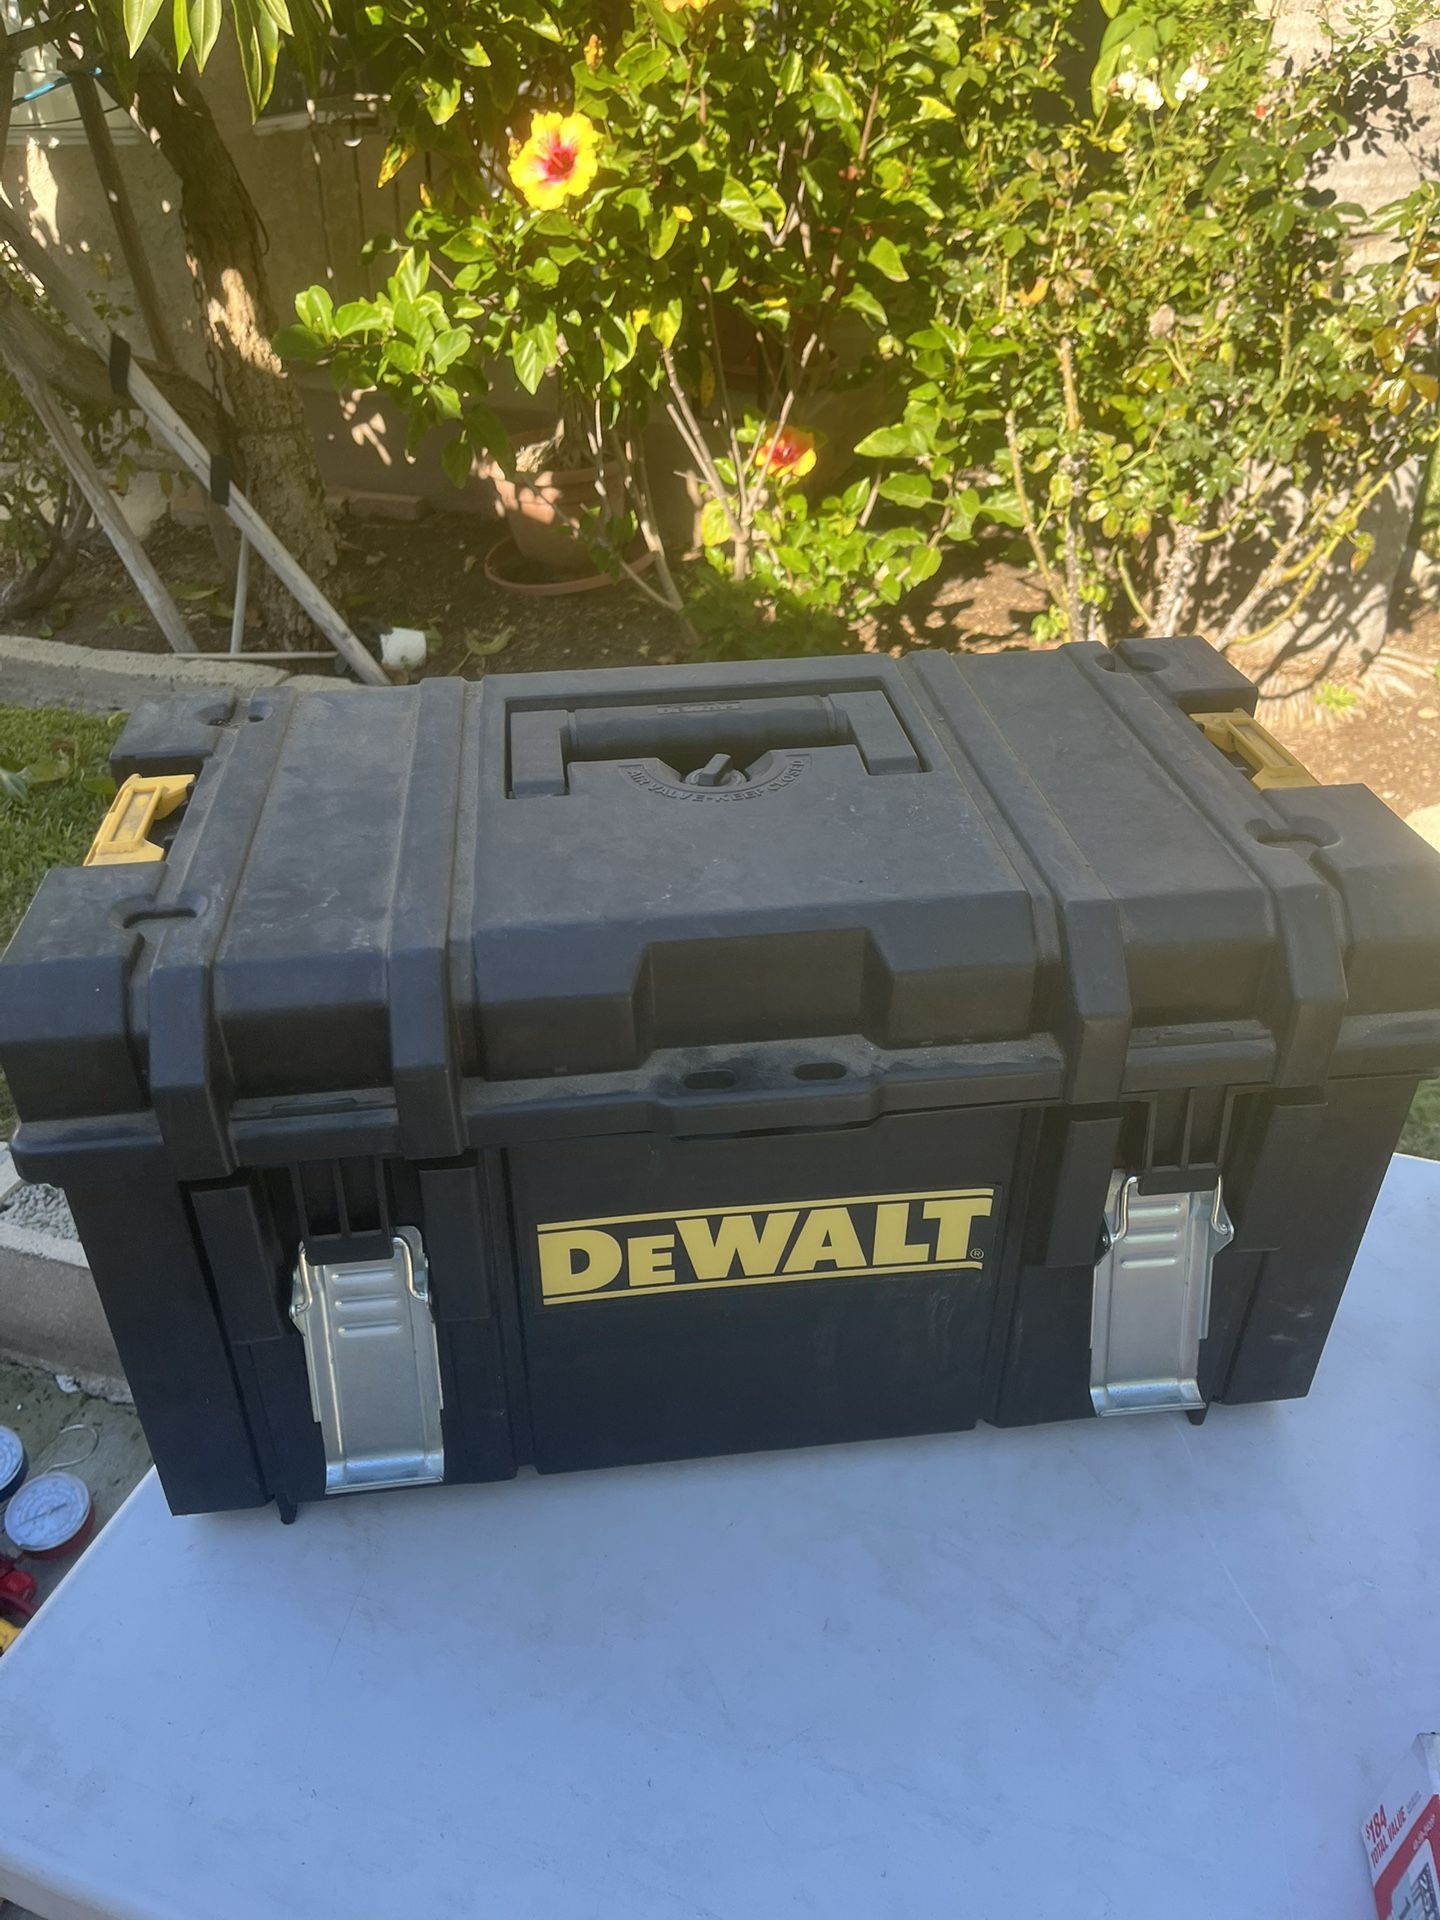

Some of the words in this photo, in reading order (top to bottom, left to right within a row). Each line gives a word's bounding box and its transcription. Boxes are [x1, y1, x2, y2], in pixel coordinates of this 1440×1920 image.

[627, 767, 649, 786] AIR
[767, 760, 805, 791] CLOSED
[1371, 1834, 1388, 1869] TOTAL
[1388, 1806, 1406, 1842] VALUE
